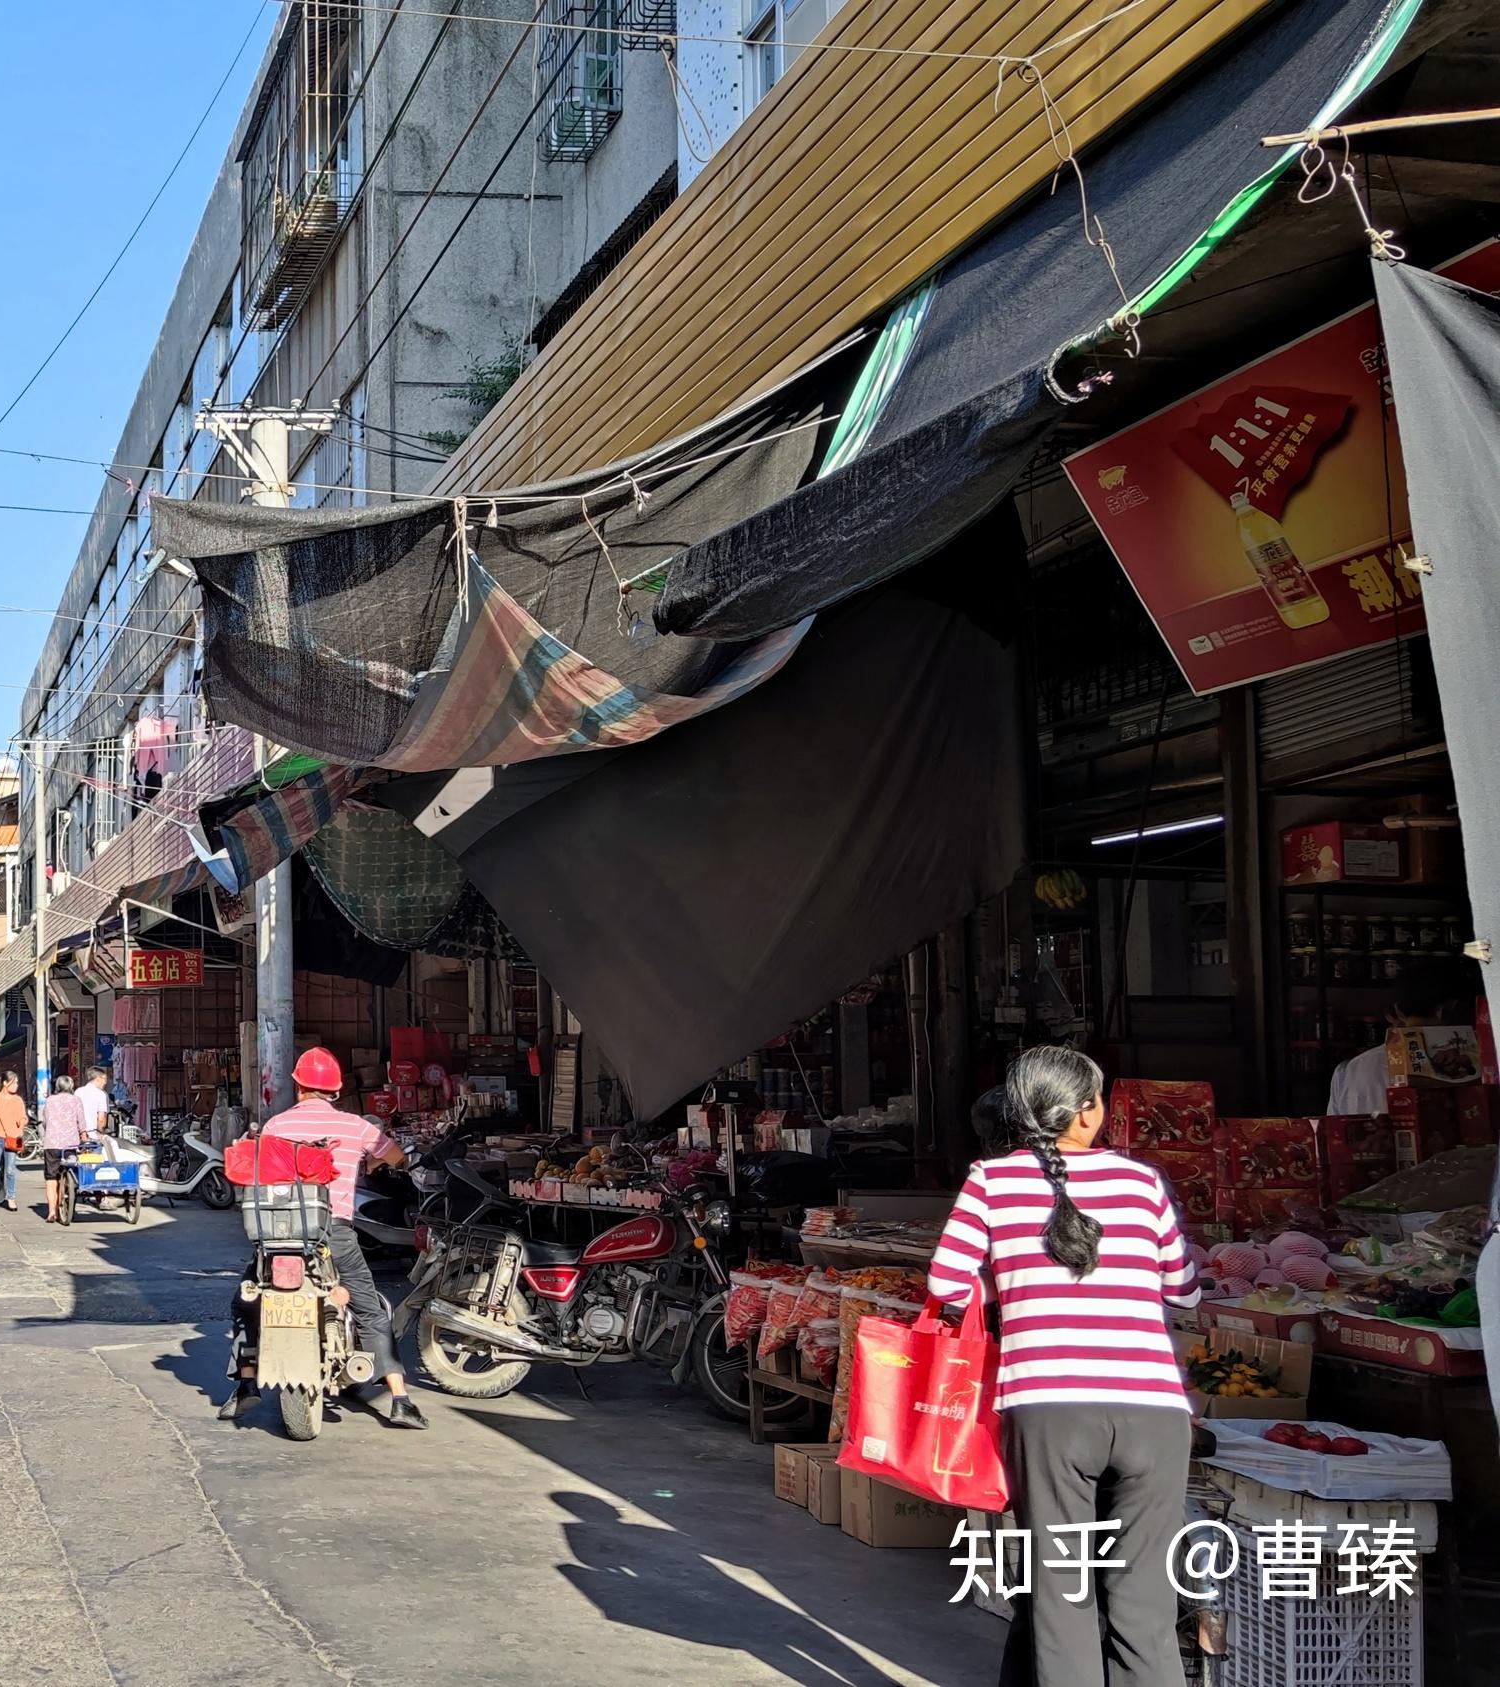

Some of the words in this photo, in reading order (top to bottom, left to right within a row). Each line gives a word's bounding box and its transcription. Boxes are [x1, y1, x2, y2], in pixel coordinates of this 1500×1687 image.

[1209, 396, 1290, 469] 1:1:1
[1251, 413, 1317, 498] 平衡营养更健康
[132, 954, 180, 982] 五金店
